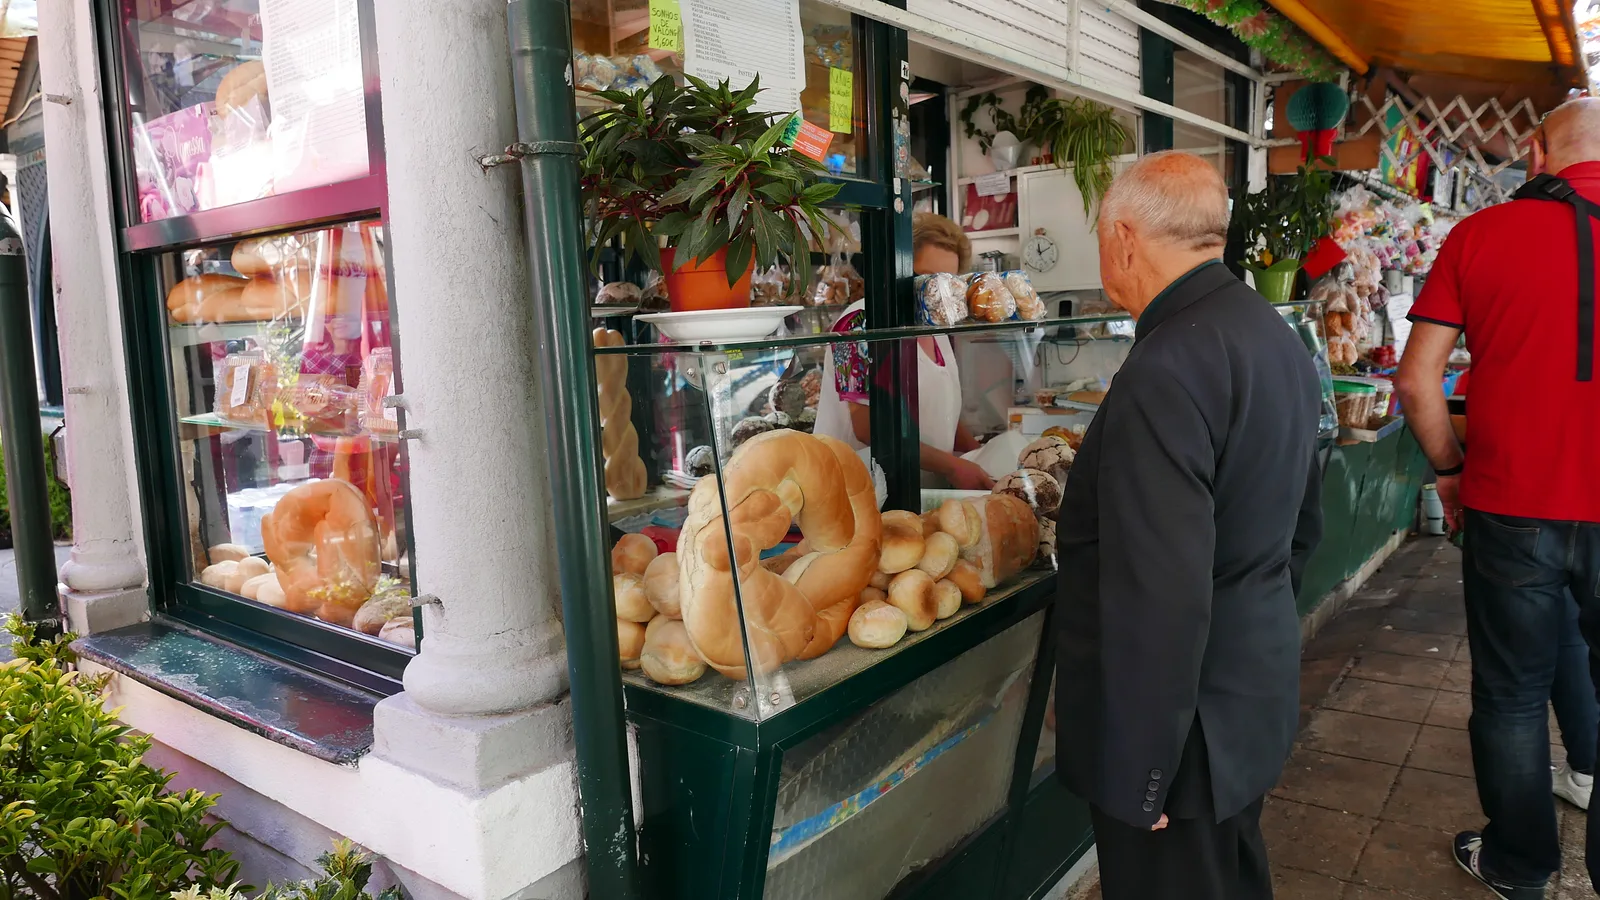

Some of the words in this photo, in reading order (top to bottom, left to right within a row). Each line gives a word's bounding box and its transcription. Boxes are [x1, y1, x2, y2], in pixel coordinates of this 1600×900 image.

[651, 7, 679, 21] SONHOS
[661, 19, 670, 28] DE
[738, 69, 763, 80] PASTELA
